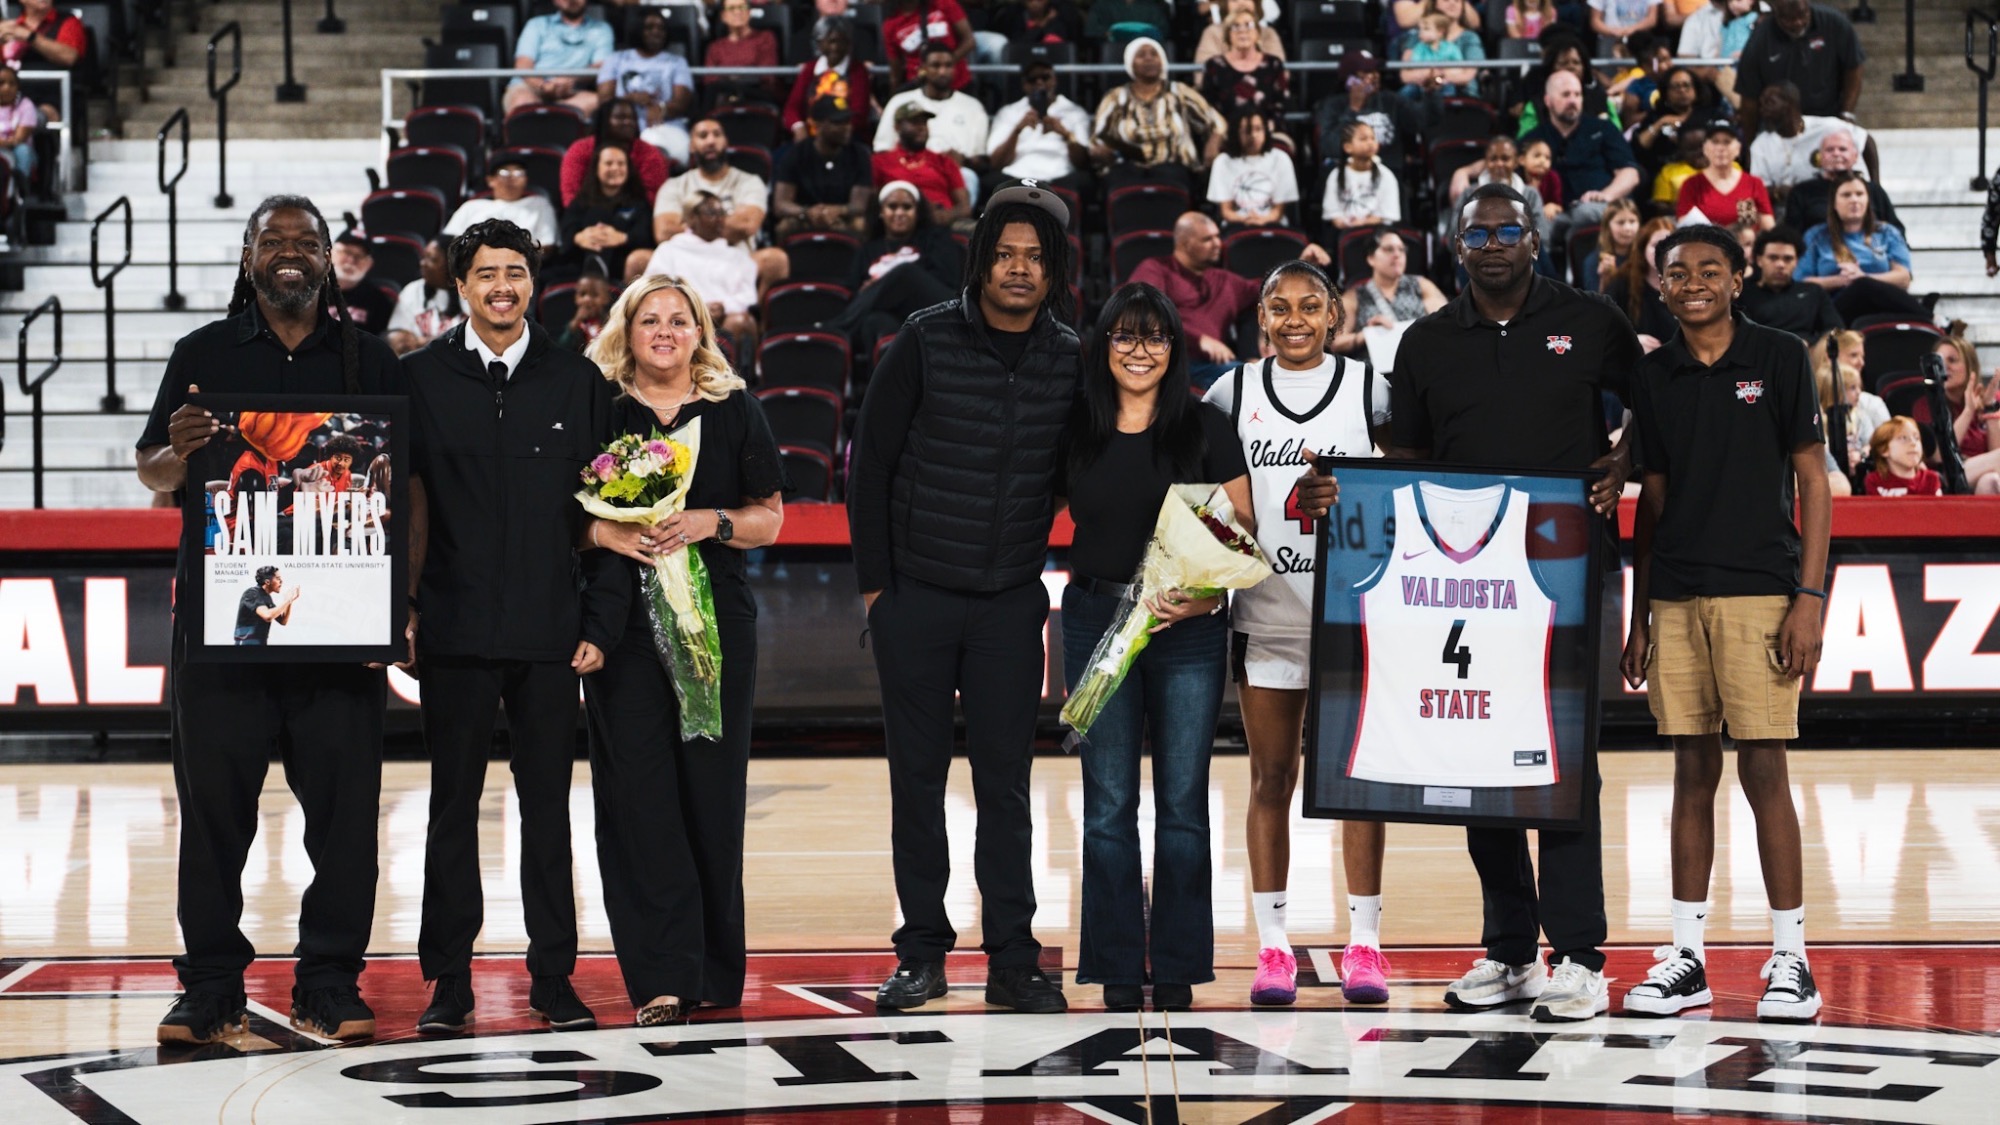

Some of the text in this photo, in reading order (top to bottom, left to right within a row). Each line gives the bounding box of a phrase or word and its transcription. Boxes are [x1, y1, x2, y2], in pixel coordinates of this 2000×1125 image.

[214, 490, 387, 557] SAM MYERS
[1272, 547, 1316, 574] Sta
[1401, 575, 1518, 610] VALDOSTA
[1442, 619, 1472, 679] 4
[1420, 688, 1491, 719] STATE
[340, 1027, 2000, 1109] STATE
